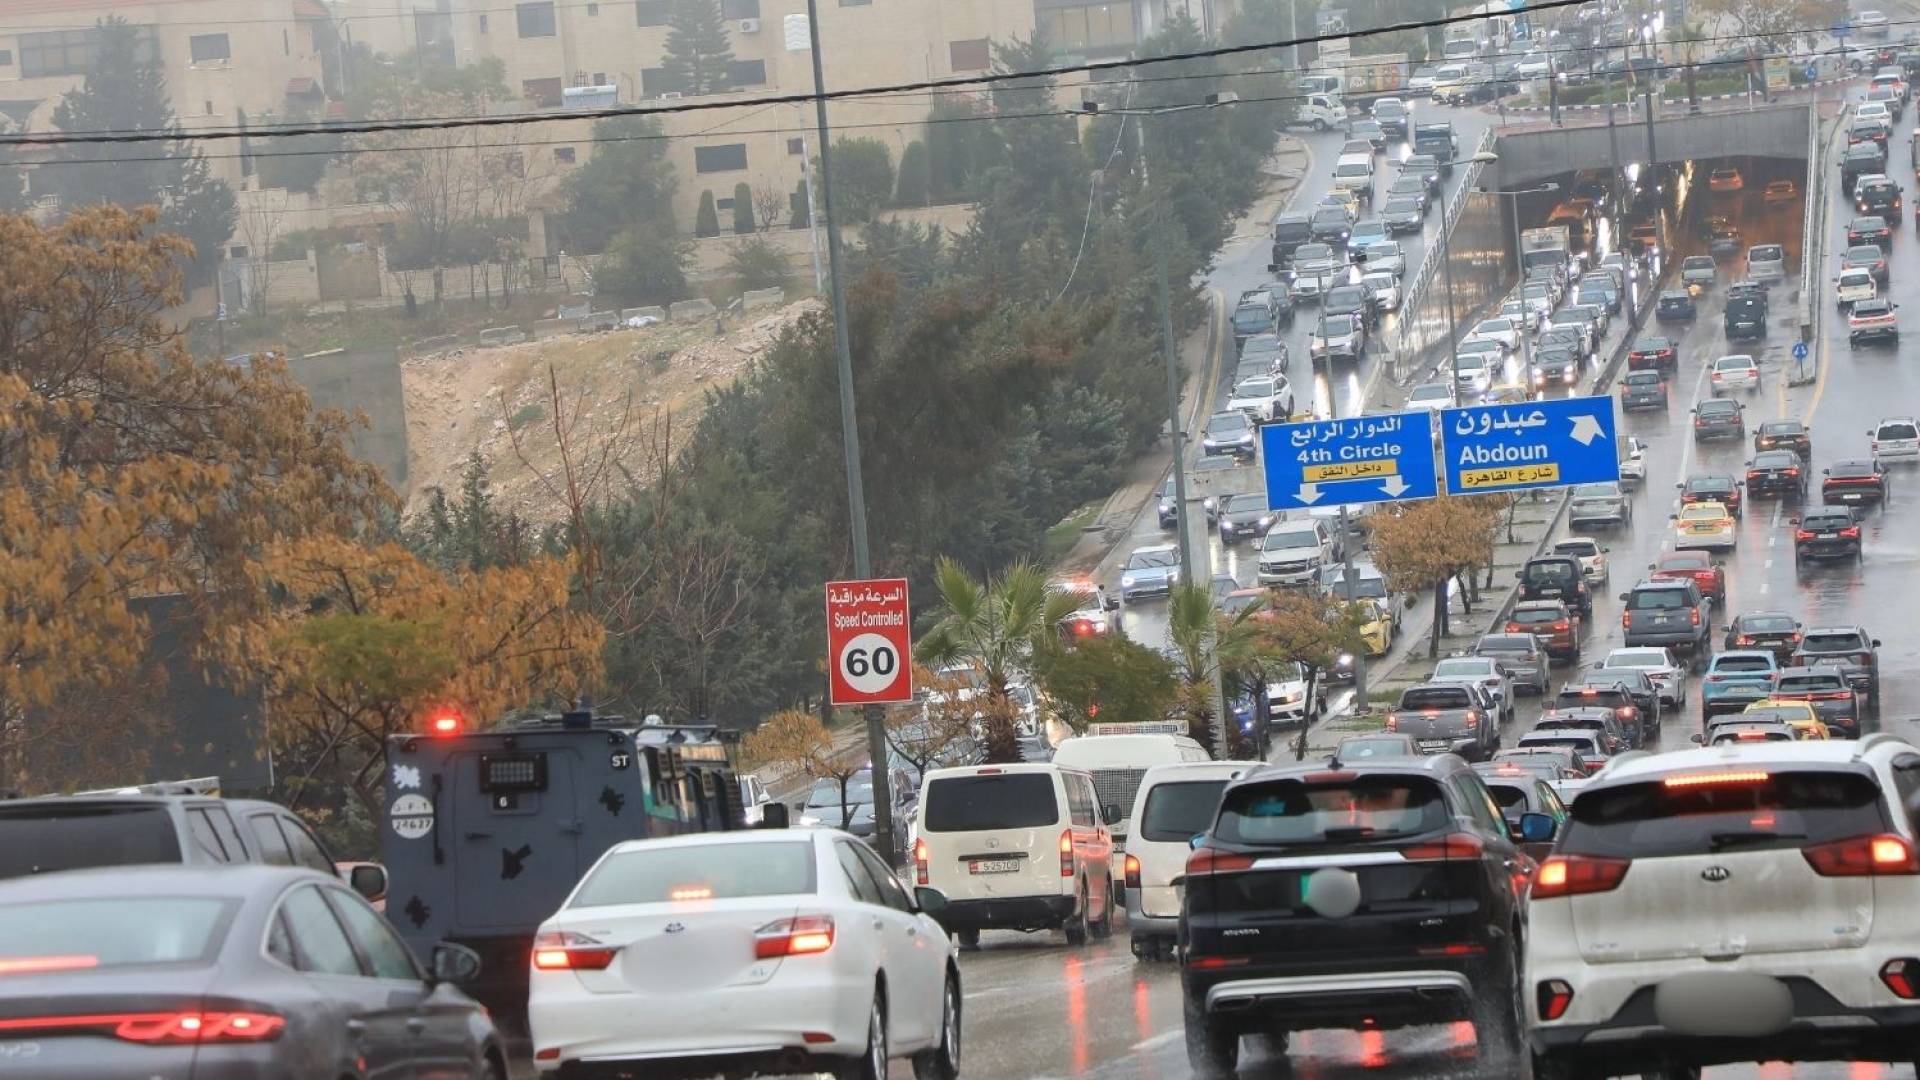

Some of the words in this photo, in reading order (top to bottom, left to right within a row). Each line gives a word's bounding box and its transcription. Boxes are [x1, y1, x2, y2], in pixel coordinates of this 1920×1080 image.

[1349, 418, 1401, 439] الدوار
[1456, 409, 1547, 436] عبدون
[1291, 422, 1343, 447] الرابع
[1297, 448, 1332, 463] 4th
[1340, 443, 1401, 460] Circle
[1459, 443, 1548, 465] Abdoun
[1319, 466, 1348, 479] النفق
[1351, 464, 1382, 476] داخل
[1466, 470, 1512, 485] القاهرة
[1517, 466, 1553, 482] شارع
[829, 588, 864, 607] مراقبة
[865, 586, 903, 606] السرعة
[834, 611, 860, 631] Speed
[861, 610, 904, 627] Controlled
[846, 646, 895, 677] 60
[611, 754, 629, 767] ST
[1702, 868, 1728, 879] KIA
